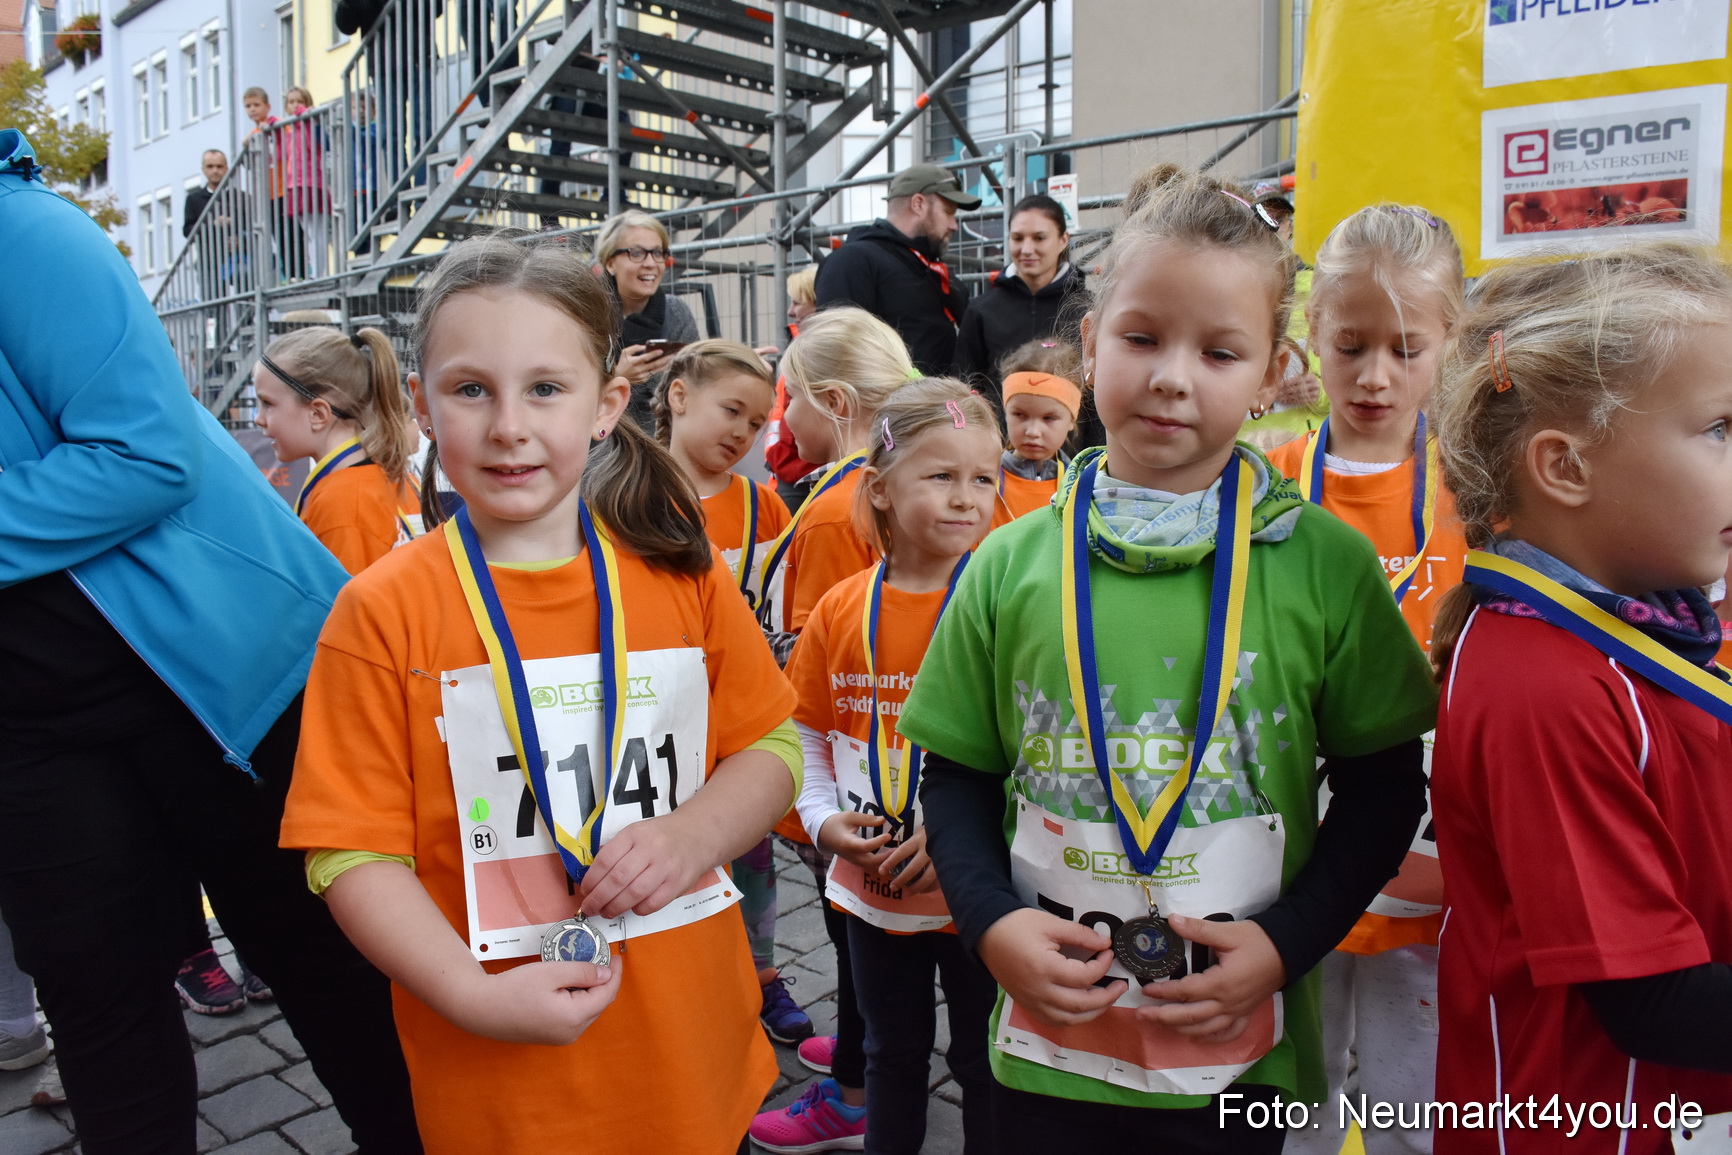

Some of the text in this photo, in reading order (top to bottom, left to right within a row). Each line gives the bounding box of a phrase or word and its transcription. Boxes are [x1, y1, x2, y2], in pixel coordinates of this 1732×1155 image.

[1552, 149, 1689, 174] PFLASTERSTEINE
[558, 676, 657, 706] BOK
[562, 705, 593, 716] inspired
[627, 699, 659, 709] concepts
[1059, 732, 1235, 780] BOCK
[496, 733, 679, 839] 7141
[474, 832, 492, 849] B1
[1092, 874, 1125, 885] inspired
[1126, 877, 1138, 887] by
[1165, 876, 1201, 888] concepts
